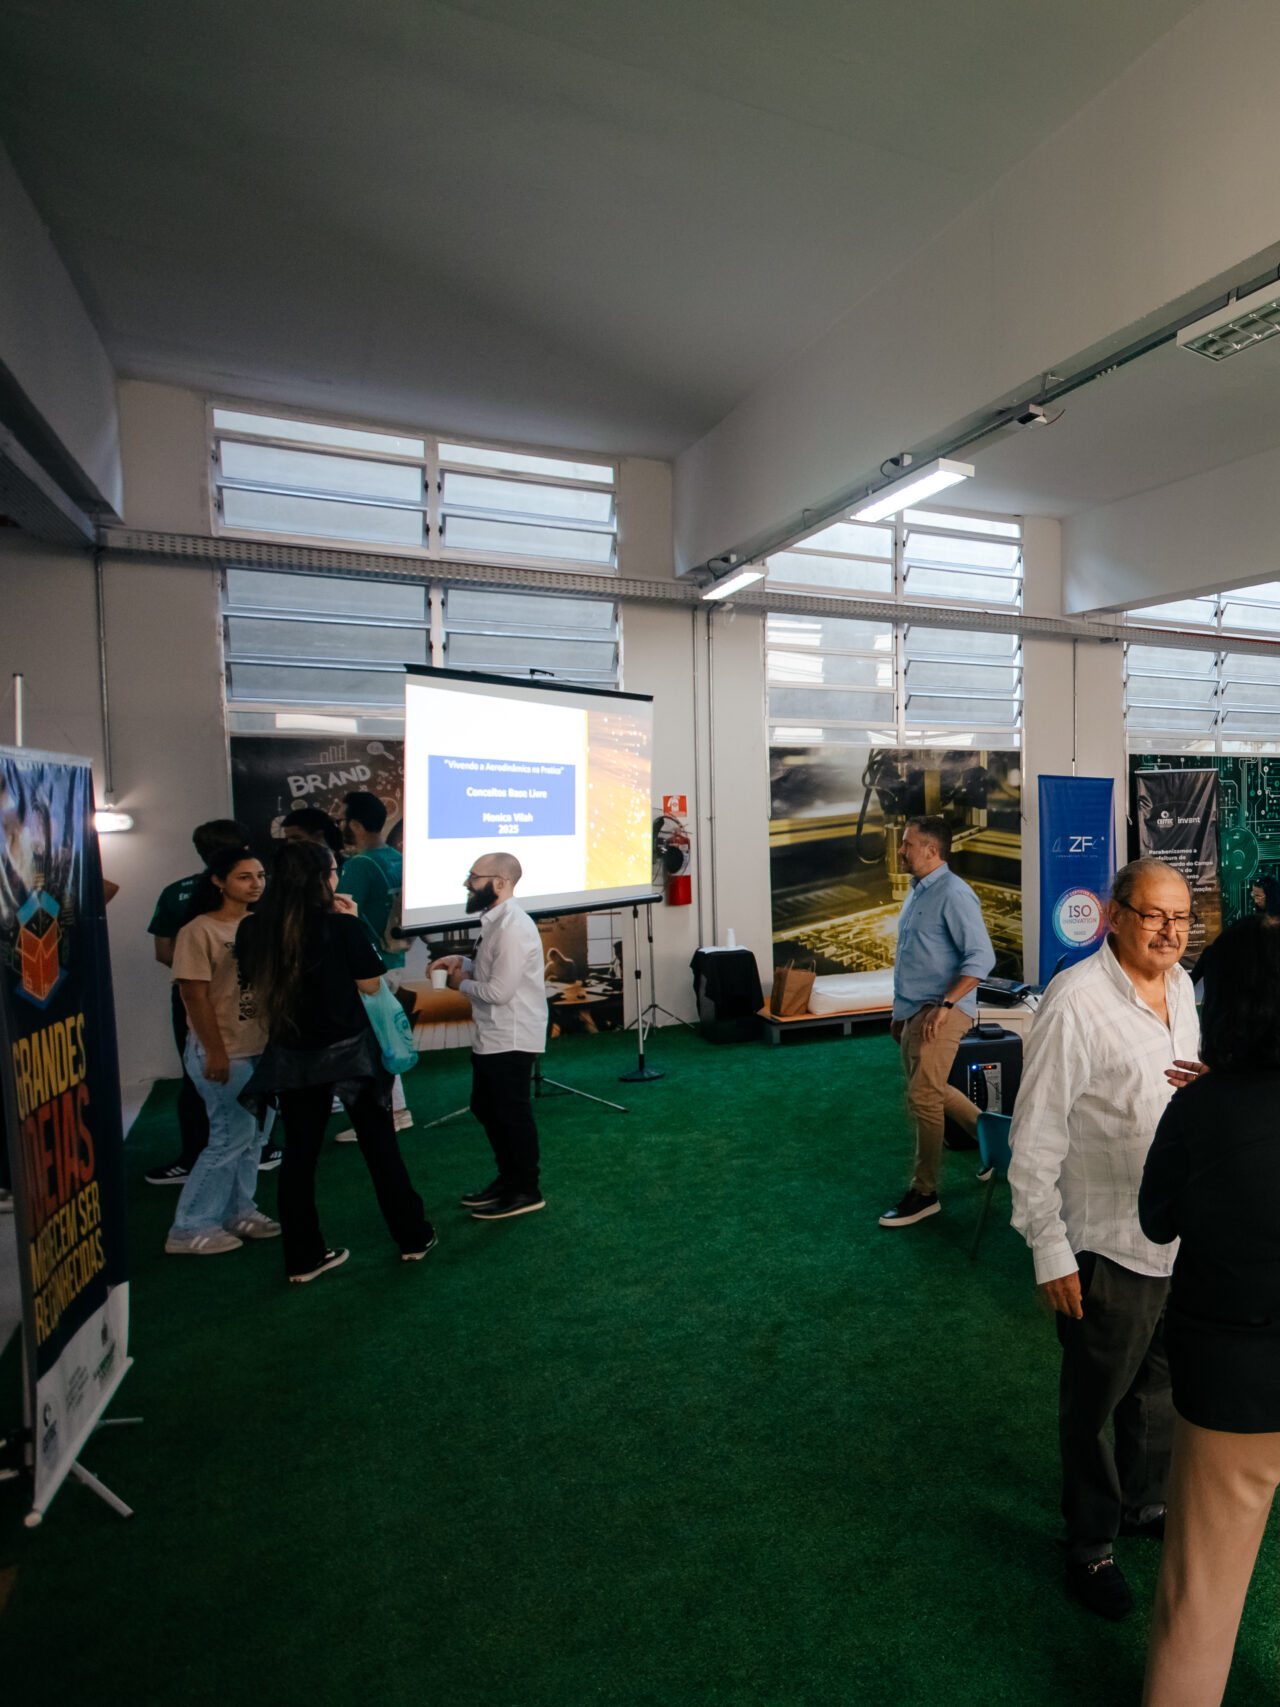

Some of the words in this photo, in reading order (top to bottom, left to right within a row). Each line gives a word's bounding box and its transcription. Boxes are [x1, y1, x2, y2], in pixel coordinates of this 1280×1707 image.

[287, 765, 371, 798] BRAND
[466, 787, 507, 798] Conceitos
[508, 788, 527, 798] Base
[529, 788, 548, 799] Livre
[498, 824, 519, 834] 2025
[1069, 836, 1093, 852] ZF
[1069, 905, 1092, 918] ISO
[13, 1012, 87, 1121] GRANDES
[78, 1180, 102, 1238] SER
